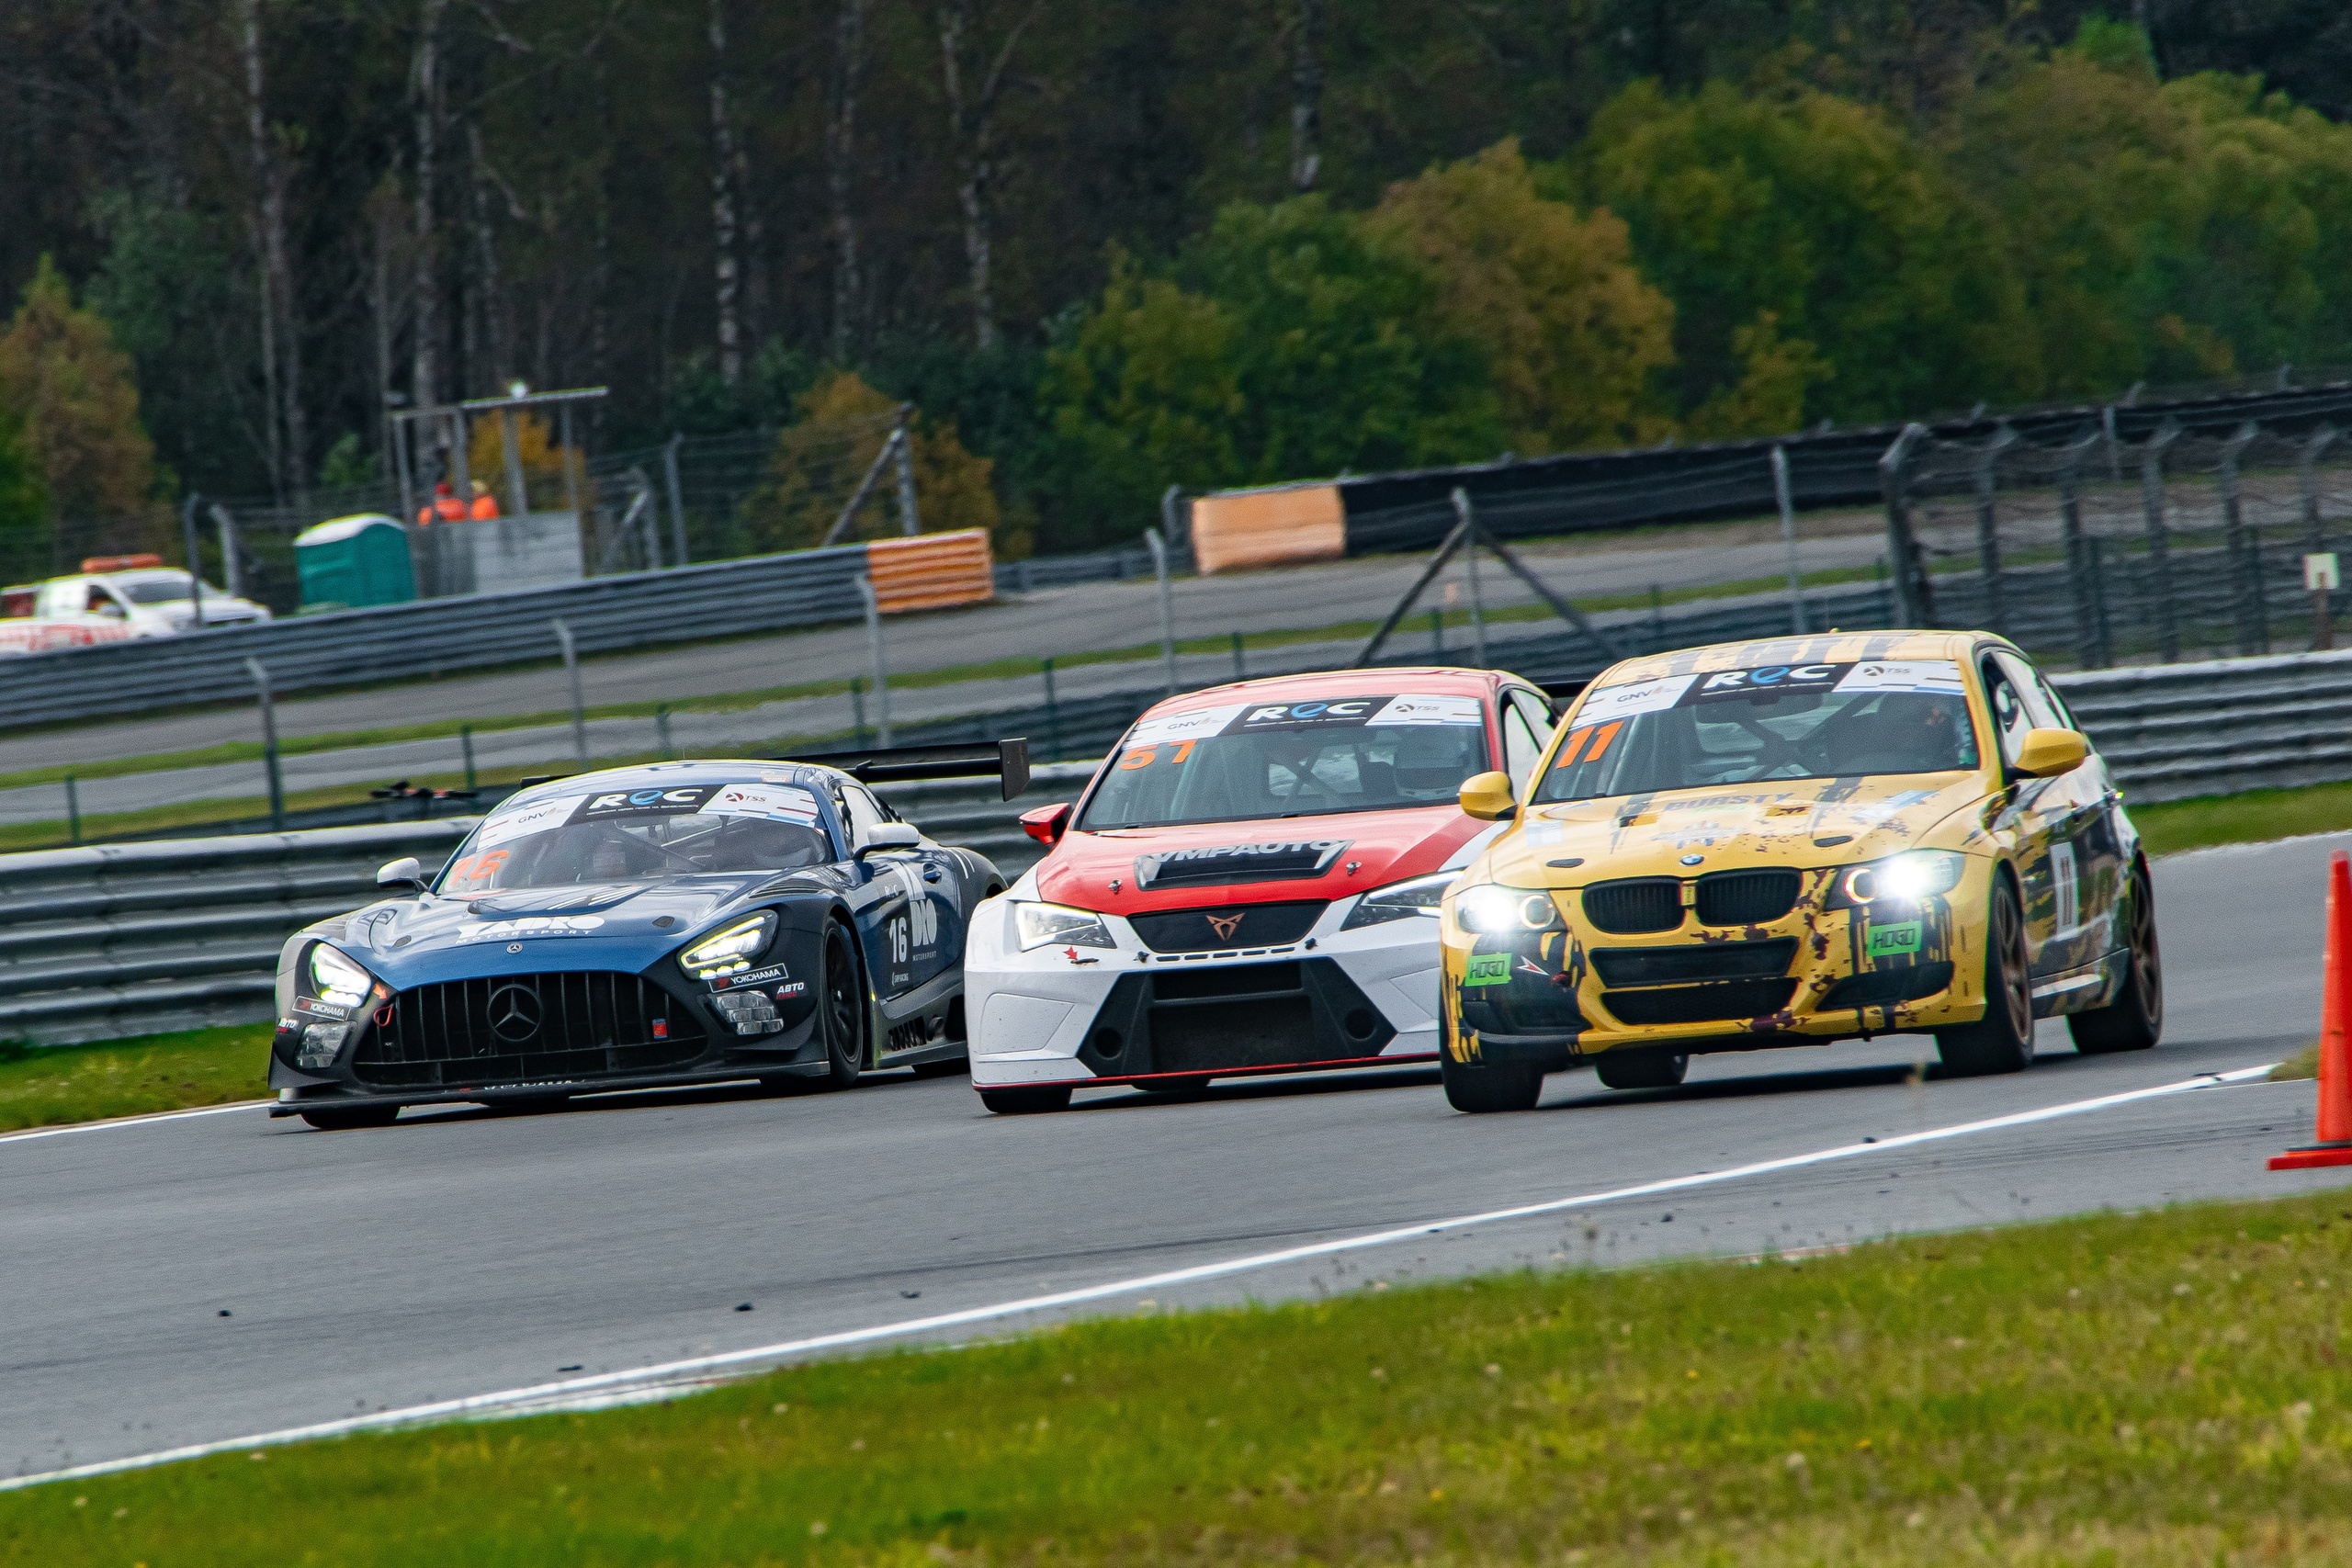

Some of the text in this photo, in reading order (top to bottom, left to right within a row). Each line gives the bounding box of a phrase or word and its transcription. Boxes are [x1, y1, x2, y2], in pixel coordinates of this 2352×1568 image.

[1120, 739, 1198, 770] 57
[1555, 720, 1624, 769] 11
[449, 850, 510, 886] 16
[456, 929, 593, 945] MOTORSPORT
[888, 917, 908, 963] 16
[730, 968, 781, 985] YOKOHAMA
[777, 982, 805, 995] АВТО
[310, 1002, 345, 1017] YOKOHAMA
